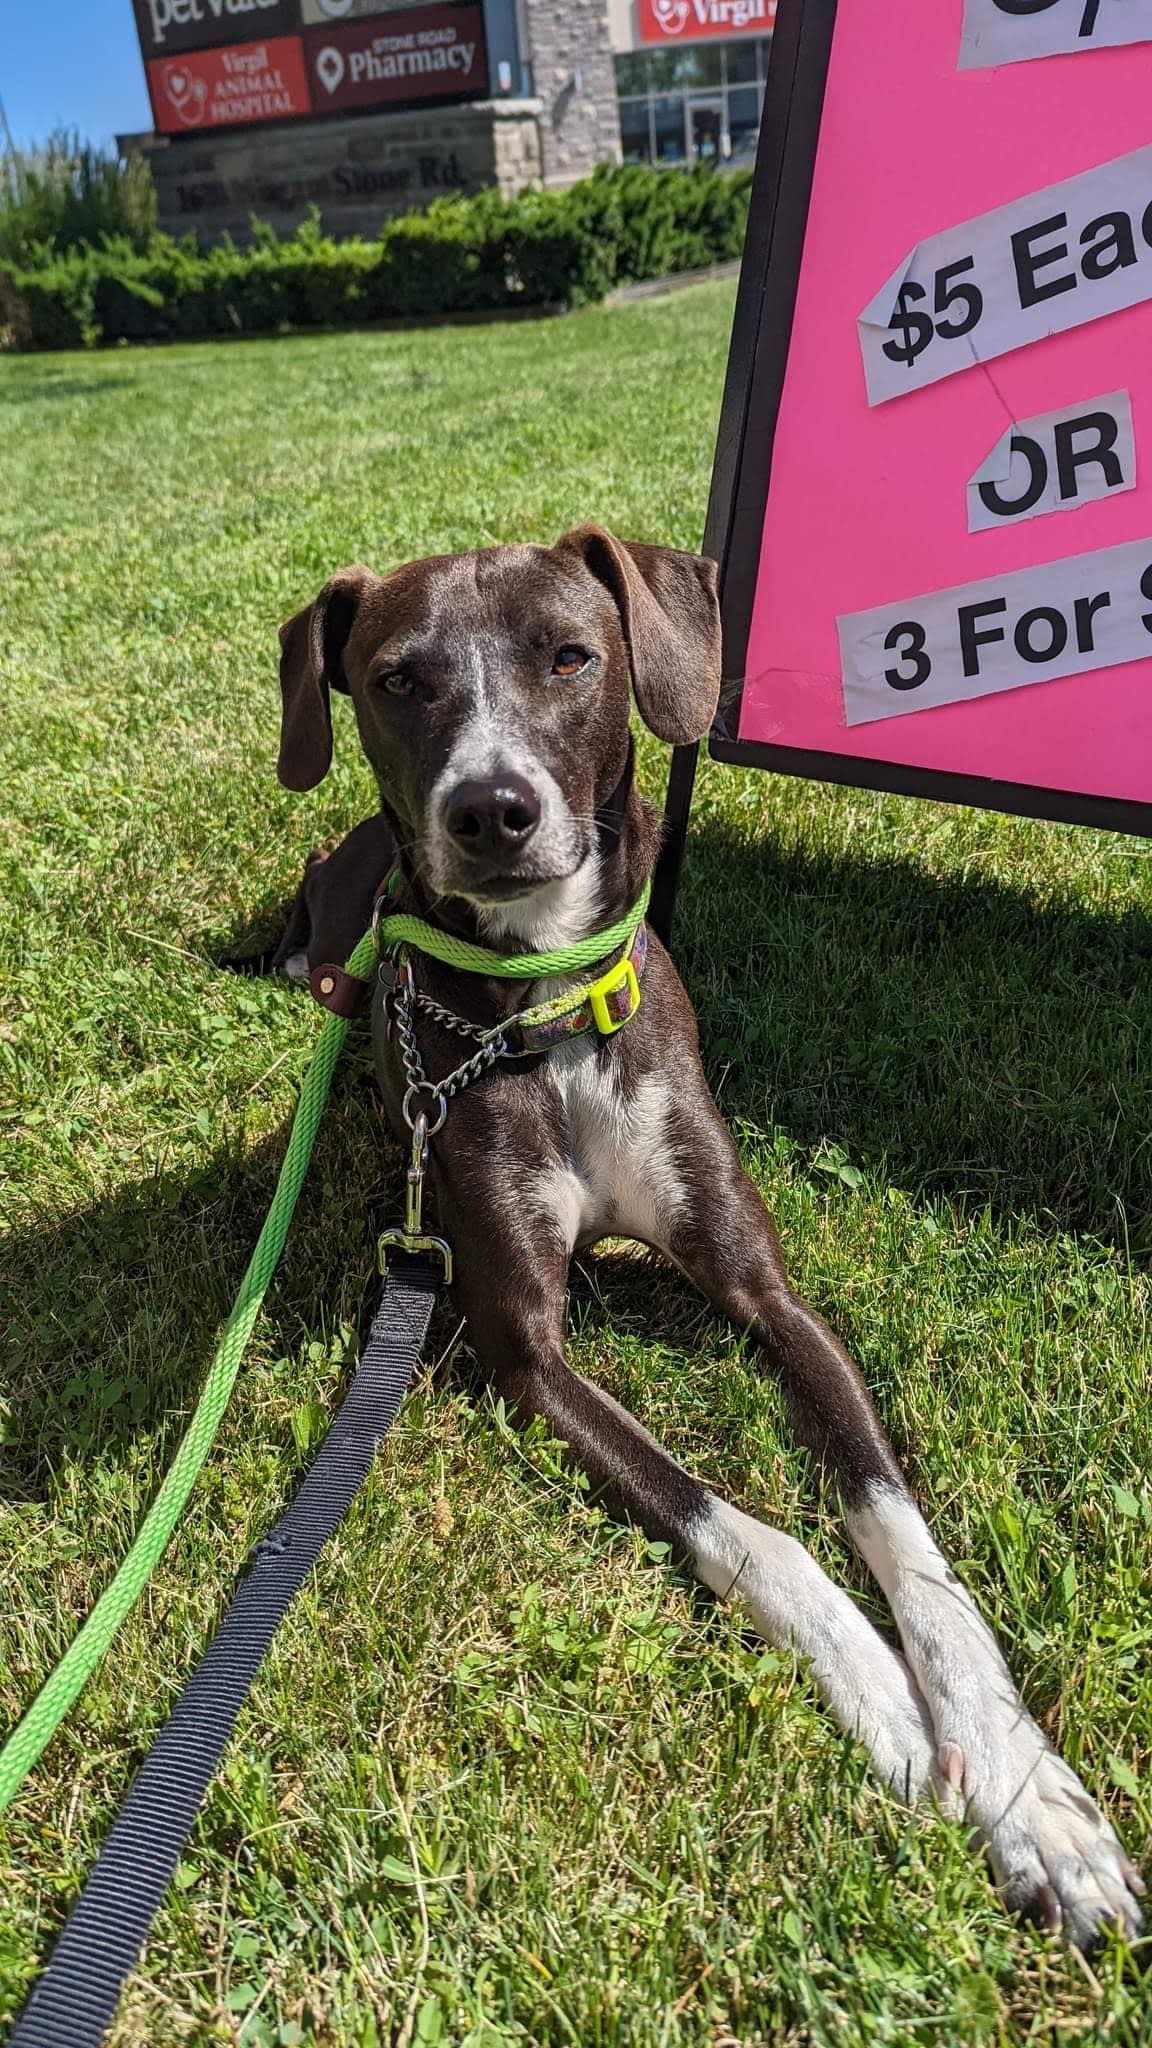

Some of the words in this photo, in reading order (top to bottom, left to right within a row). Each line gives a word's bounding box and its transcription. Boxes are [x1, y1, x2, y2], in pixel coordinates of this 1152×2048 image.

[371, 34, 416, 54] STONE
[417, 27, 457, 45] ROAD
[221, 47, 269, 75] Virgil
[349, 41, 475, 83] Pharmacy
[215, 70, 285, 99] ANIMAL
[210, 91, 296, 121] HOSPITAL
[882, 254, 984, 368] $5
[1010, 198, 1152, 310] Ea
[977, 411, 1125, 516] OR
[883, 620, 932, 692] 3
[958, 590, 1111, 678] For
